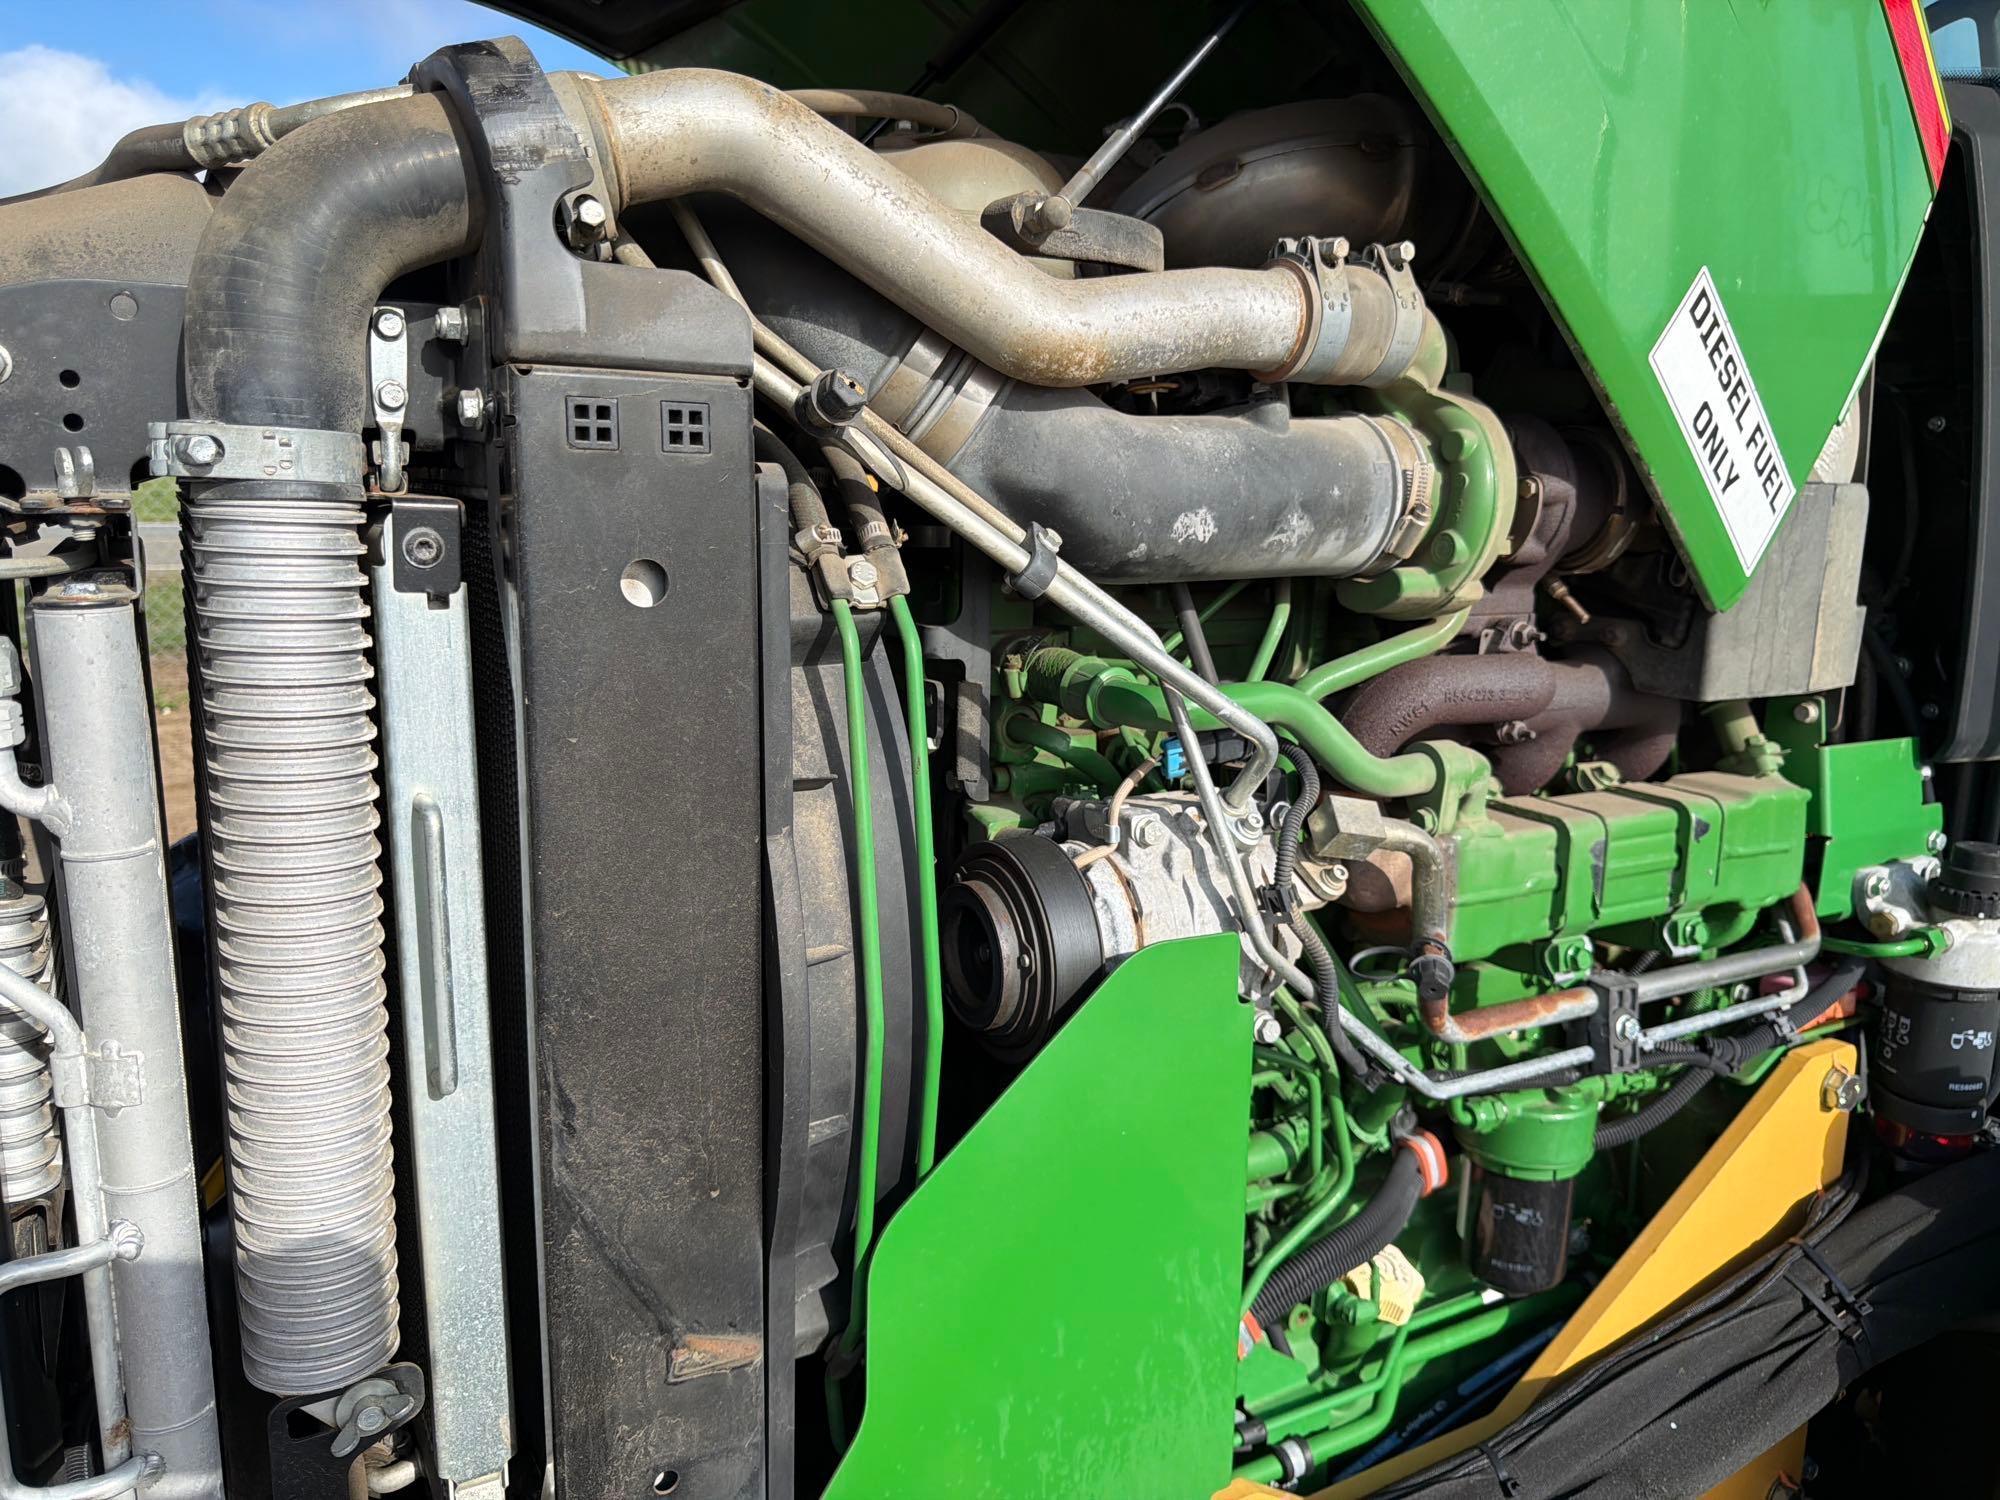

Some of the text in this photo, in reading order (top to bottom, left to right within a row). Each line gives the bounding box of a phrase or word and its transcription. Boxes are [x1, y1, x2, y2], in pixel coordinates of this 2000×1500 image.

[1689, 286, 1784, 514] DIESEL FUEL
[1692, 401, 1740, 495] ONLY
